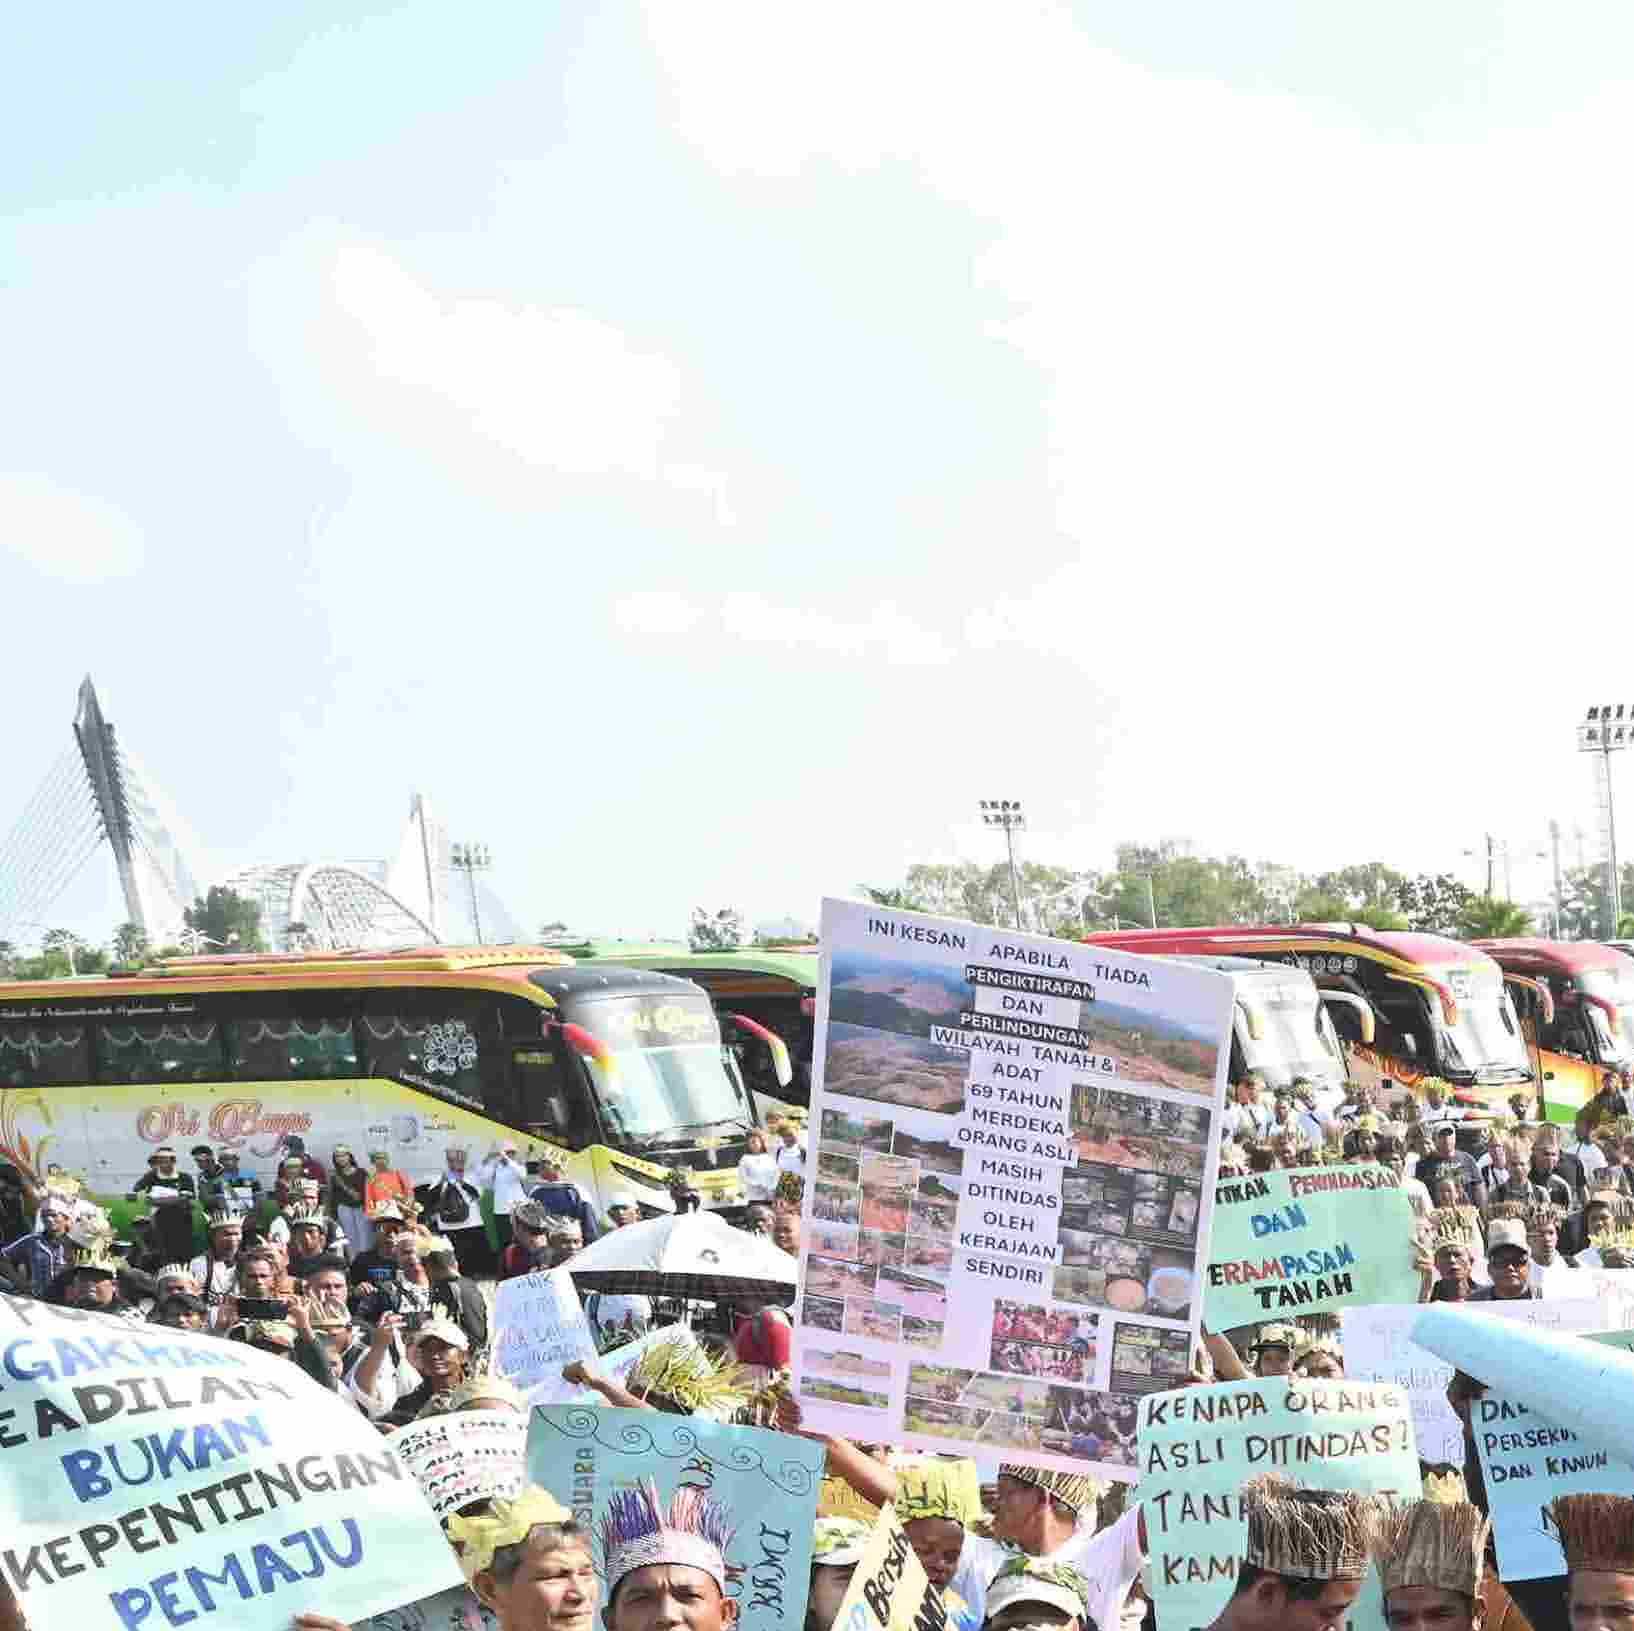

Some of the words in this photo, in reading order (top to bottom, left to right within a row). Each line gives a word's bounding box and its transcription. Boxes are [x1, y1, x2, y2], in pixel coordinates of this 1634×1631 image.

[867, 918, 896, 939] INI
[900, 923, 967, 950] KESAN
[989, 943, 1070, 970] APABILA
[1093, 963, 1150, 988] TIADA
[966, 966, 1096, 999] PENGIKTIRAFAN
[1001, 996, 1044, 1017] DAN
[960, 1012, 1090, 1048] PERLINDUNGAN
[934, 1028, 1021, 1059] WILAYAH
[1031, 1046, 1096, 1070] TANAH
[1101, 1058, 1114, 1072] &
[992, 1064, 1042, 1083] ADAT
[996, 1088, 1063, 1112] TAHUN
[972, 1107, 1066, 1135] MERDEKA
[957, 1128, 1028, 1155] ORANG
[1032, 1141, 1073, 1162] ASLI
[981, 1160, 1043, 1182] MASIH
[967, 1183, 1057, 1209] DITINDAS
[983, 1211, 1034, 1233] OLEH
[1249, 1204, 1307, 1241] DAN
[960, 1232, 1056, 1259] KERAJAAN
[966, 1259, 1043, 1284] SENDIRI
[1254, 1272, 1354, 1311] TANAH
[1145, 1391, 1268, 1427] KENAPA
[1285, 1388, 1401, 1414] ORANG
[60, 1413, 273, 1503] BUKAN
[1146, 1438, 1225, 1475] ASLI
[1245, 1426, 1409, 1466] DITINDAS?
[1488, 1461, 1533, 1484] DAN
[1, 1450, 403, 1592] KEPENTINGAN
